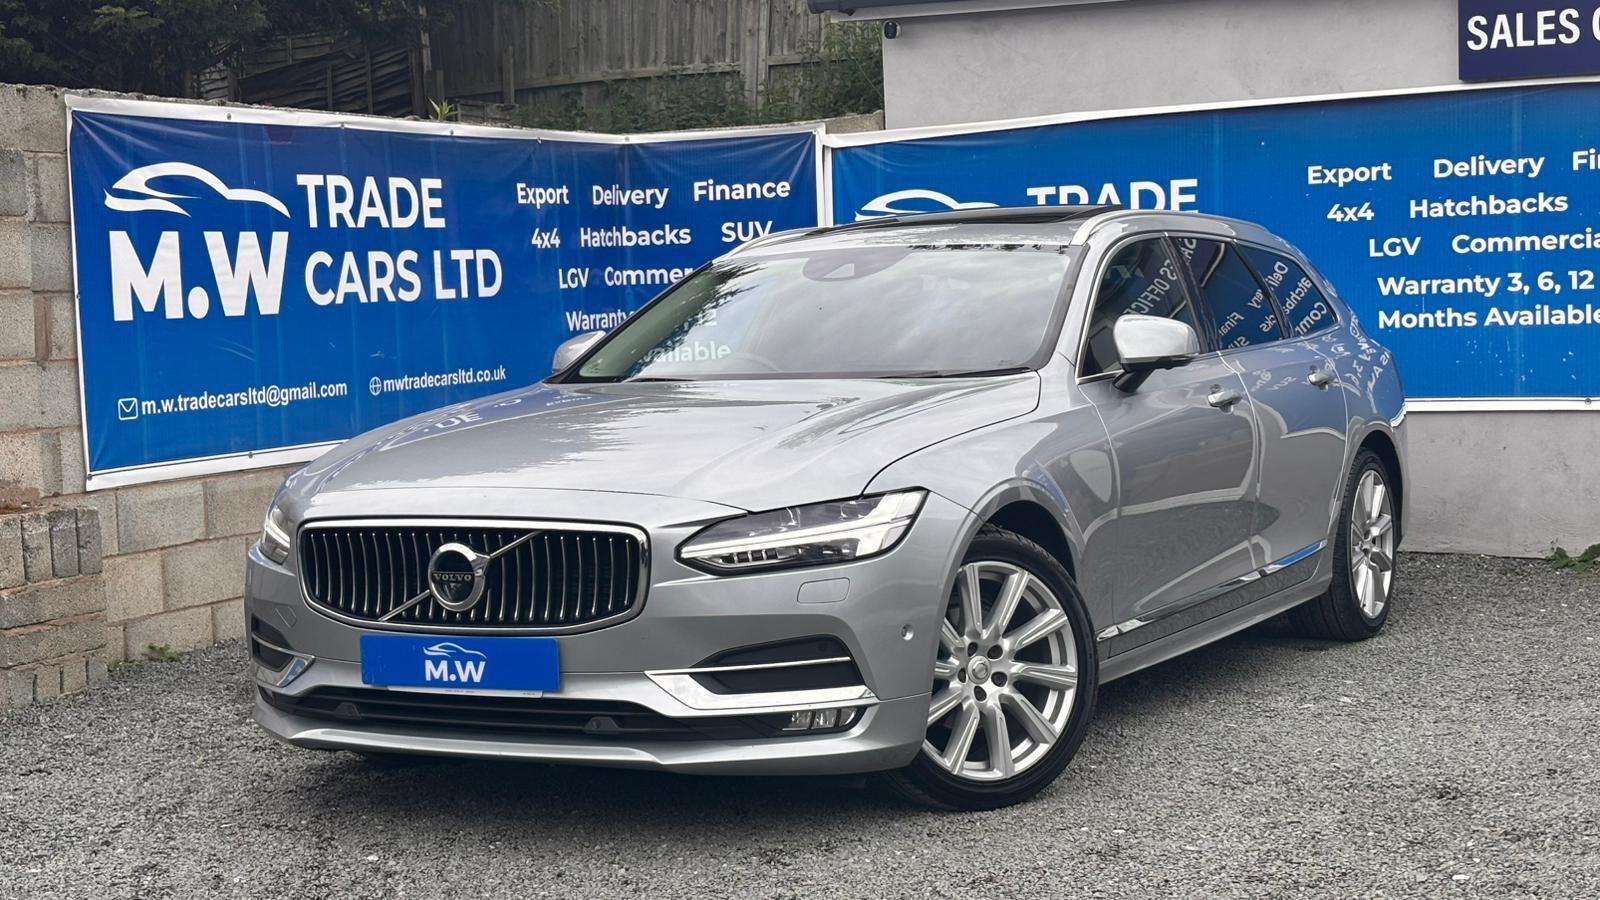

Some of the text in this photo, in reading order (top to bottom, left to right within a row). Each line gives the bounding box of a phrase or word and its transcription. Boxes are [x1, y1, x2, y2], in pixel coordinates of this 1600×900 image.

[1467, 8, 1580, 51] SALES
[1308, 162, 1392, 187] Export
[1433, 155, 1545, 178] Delivery
[297, 174, 446, 229] TRADE
[516, 179, 790, 209] Export Delivery Finance
[1327, 192, 1568, 222] 4x4 Hatchbacks
[531, 221, 773, 248] 4x4 Hatchbacks SUV
[1369, 237, 1421, 257] LGV
[109, 231, 289, 322] M.W
[305, 249, 502, 306] CARS LTD
[558, 268, 589, 289] LGV
[1377, 270, 1594, 298] Warranty 3, 6, 12
[1378, 308, 1477, 329] Months
[383, 365, 506, 393] mwtradecarsltd.co.uk
[141, 382, 347, 415] m.w.tradecarsltd@gmail.com
[433, 573, 471, 581] VOLVO
[425, 660, 486, 683] M.W
